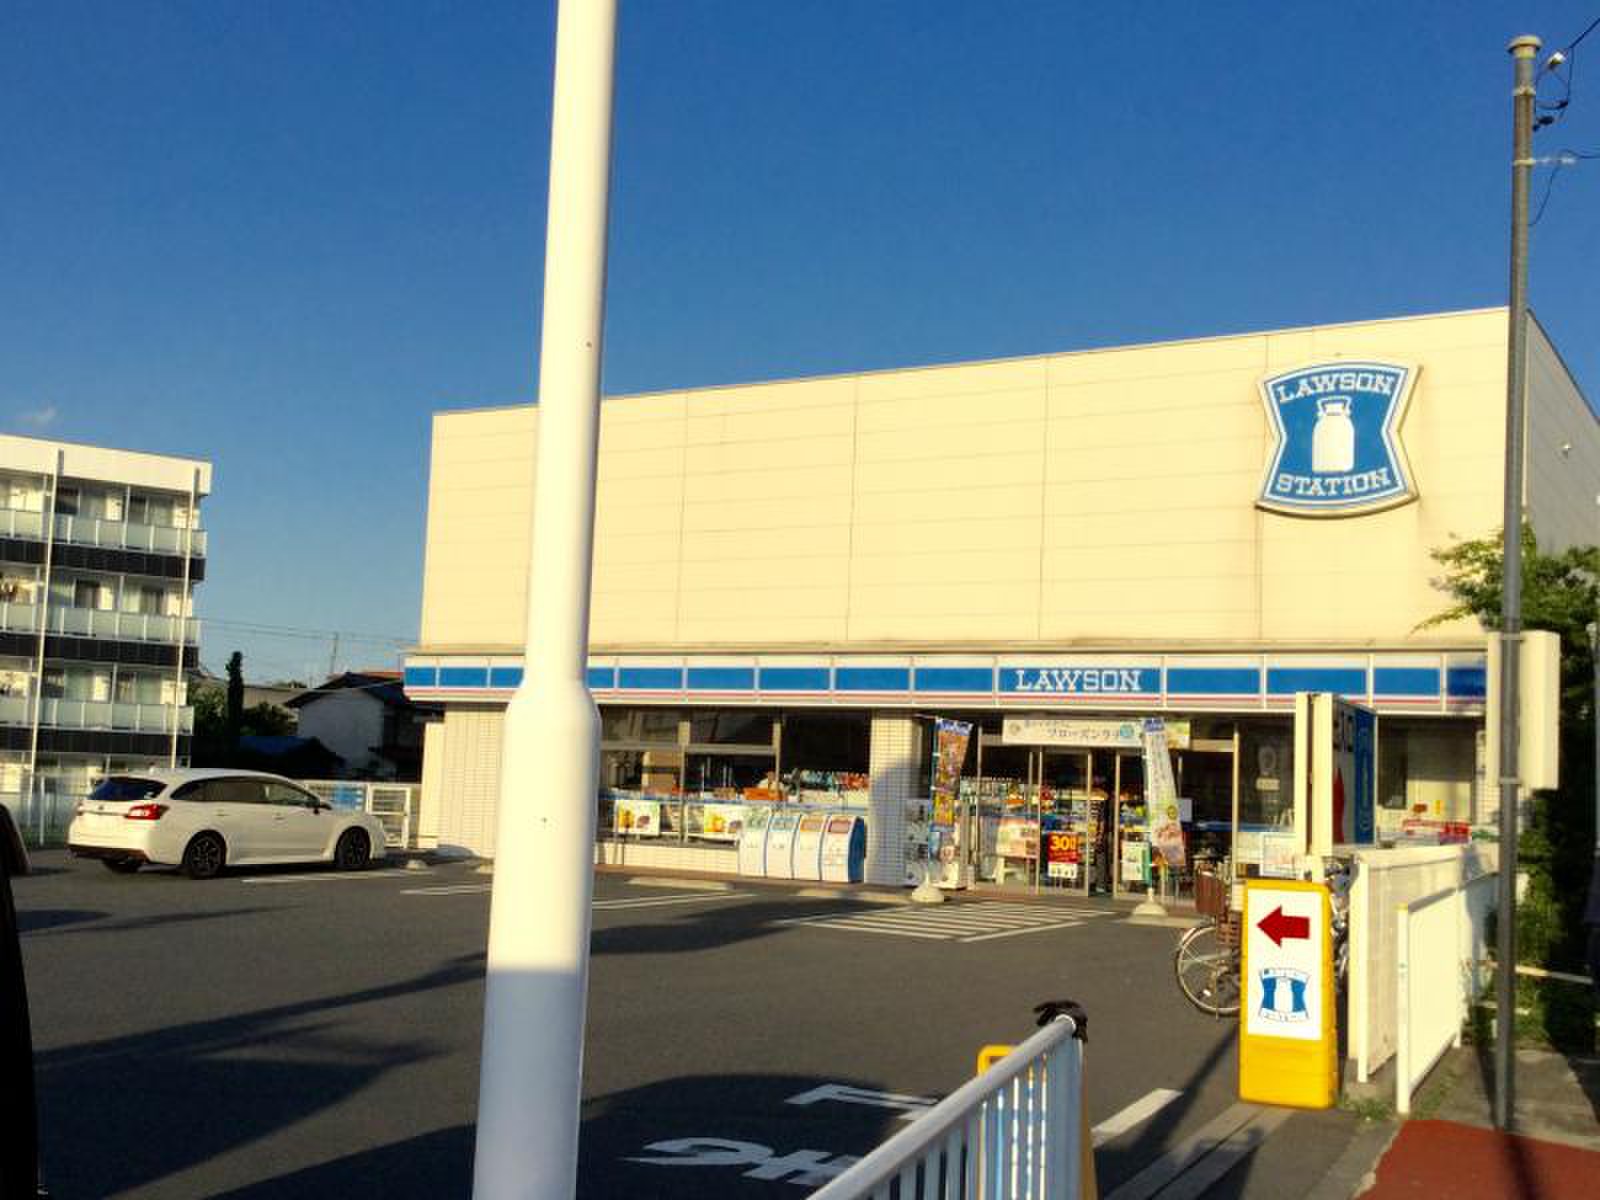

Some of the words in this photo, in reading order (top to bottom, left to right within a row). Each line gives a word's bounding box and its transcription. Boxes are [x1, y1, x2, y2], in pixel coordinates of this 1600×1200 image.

[1277, 372, 1395, 402] LAWSON
[1276, 467, 1391, 496] STATION
[1015, 669, 1142, 692] LAWSON
